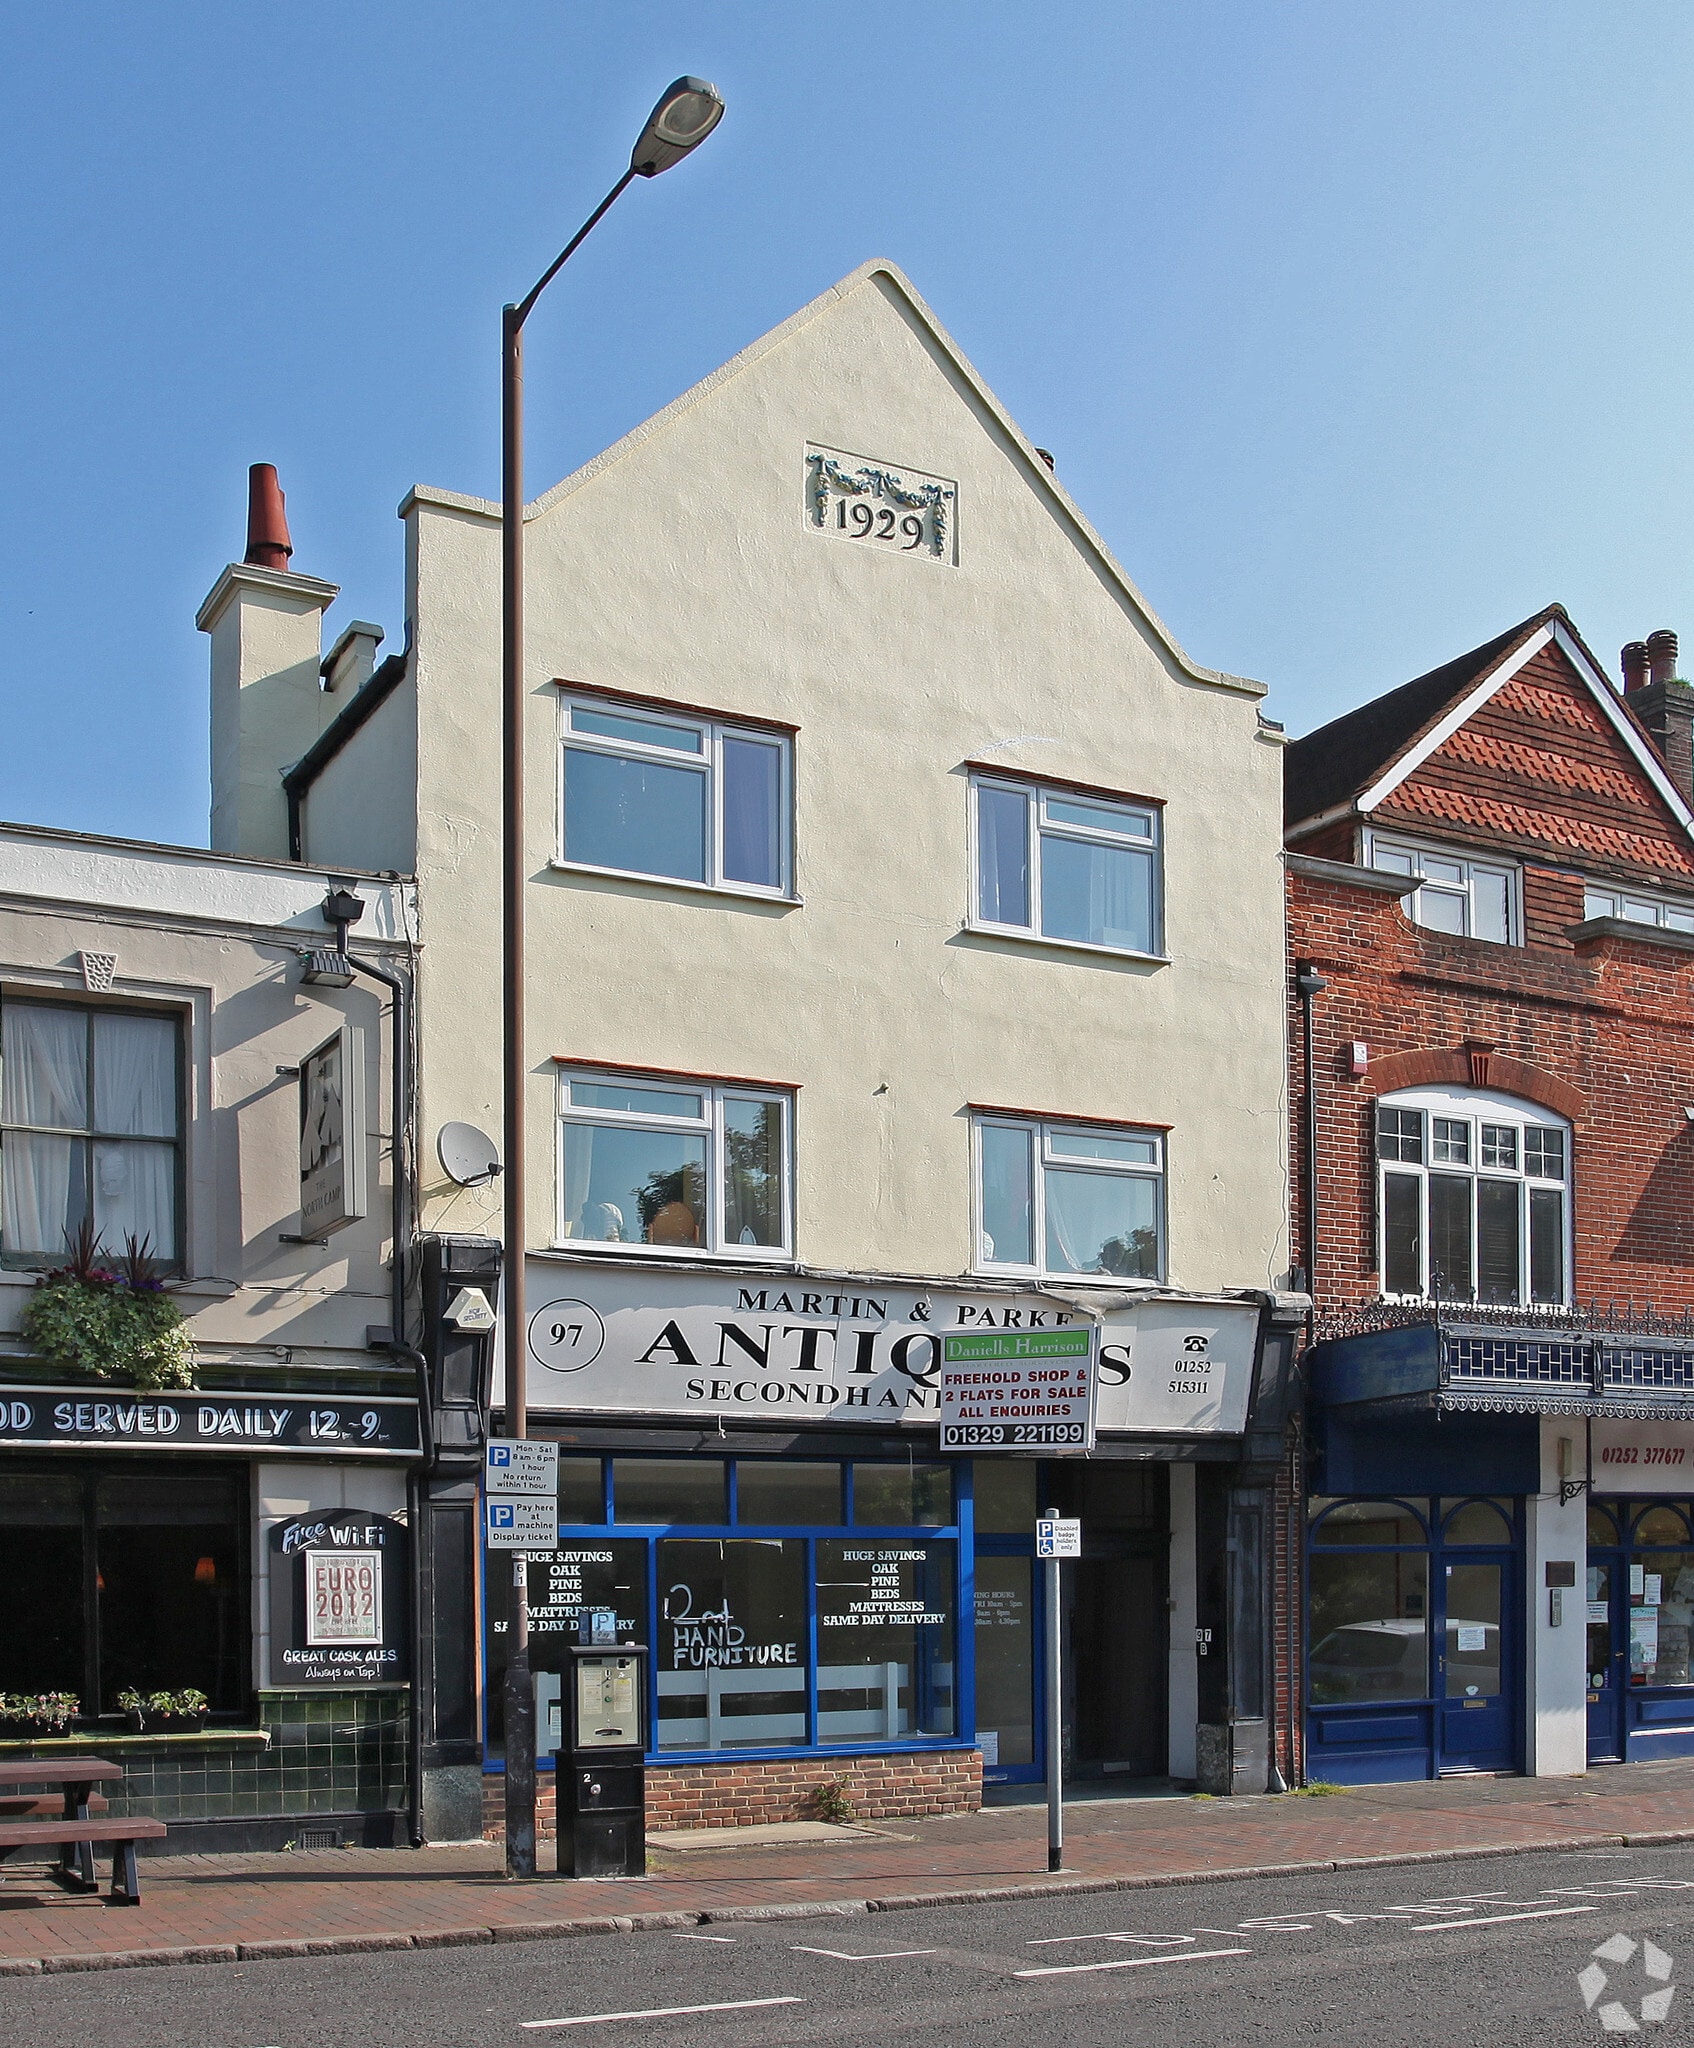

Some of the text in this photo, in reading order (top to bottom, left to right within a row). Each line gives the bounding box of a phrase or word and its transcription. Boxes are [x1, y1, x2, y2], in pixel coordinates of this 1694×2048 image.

[837, 499, 924, 550] 1929
[736, 1289, 889, 1320] MARTIN
[908, 1301, 932, 1322] &
[549, 1323, 584, 1347] 97
[633, 1319, 1132, 1388] ANTIQS
[949, 1336, 1084, 1358] Daniells Harrison
[1174, 1360, 1212, 1374] 01252
[945, 1369, 1087, 1385] FREEHOLD SHOP &
[945, 1387, 1087, 1401] 2 FLATS FOR SALE
[1168, 1381, 1208, 1394] 515311
[958, 1404, 1071, 1418] ALL ENQUIRIES
[53, 1402, 182, 1436] SERVED
[197, 1406, 293, 1437] DAILY
[946, 1424, 1083, 1444] 01329 221199
[516, 1444, 533, 1453] Mon
[539, 1445, 553, 1454] Sat
[1602, 1447, 1686, 1465] 01252 377677
[516, 1473, 542, 1481] return
[516, 1503, 554, 1512] Pay here
[517, 1521, 554, 1529] machine
[282, 1523, 326, 1554] Free
[493, 1533, 553, 1542] Display ticket
[526, 1551, 613, 1562] UGE SAVINGS
[843, 1550, 927, 1561] HUGE SAVINGS
[550, 1565, 581, 1576] OAK
[872, 1563, 899, 1574] OAK
[315, 1567, 373, 1592] EURO
[549, 1579, 582, 1590] PINE
[871, 1576, 900, 1586] PINE
[549, 1593, 582, 1604] BEDS
[871, 1589, 900, 1599] BEDS
[315, 1593, 373, 1617] 2012
[849, 1602, 925, 1613] MATTRESSES
[538, 1620, 566, 1631] DAY
[823, 1613, 946, 1626] SAME DAY DELIVERY
[673, 1625, 746, 1648] HAND
[283, 1650, 398, 1663] GREAT CASK ALES
[673, 1642, 798, 1670] FURNITURE
[305, 1663, 381, 1681] Always on Tap!
[583, 1773, 591, 1783] 2
